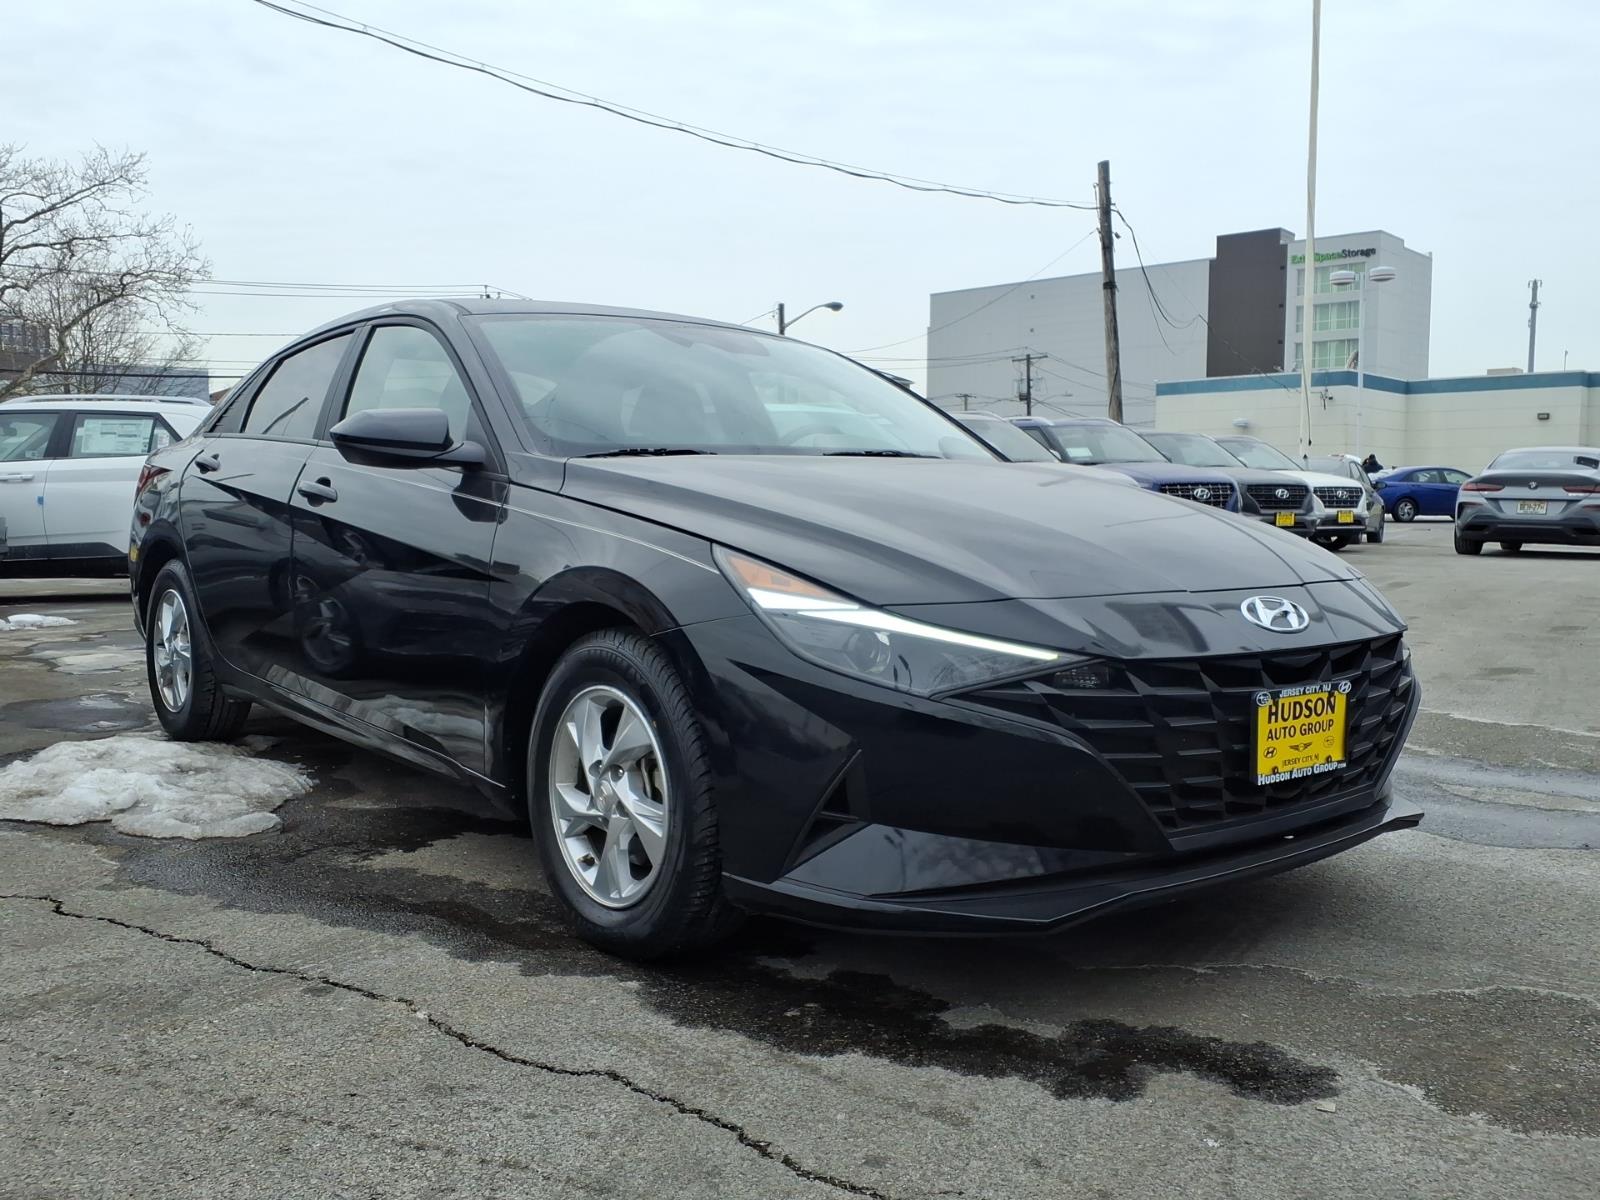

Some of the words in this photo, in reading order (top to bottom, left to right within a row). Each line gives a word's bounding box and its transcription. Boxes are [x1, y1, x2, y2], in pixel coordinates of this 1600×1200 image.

[1279, 688, 1304, 698] JERSEY
[1322, 683, 1332, 692] NJ
[1267, 695, 1336, 724] HUDSON
[1266, 724, 1297, 742] AUTO
[1299, 718, 1334, 736] GROUP
[1283, 757, 1301, 766] JERSEY
